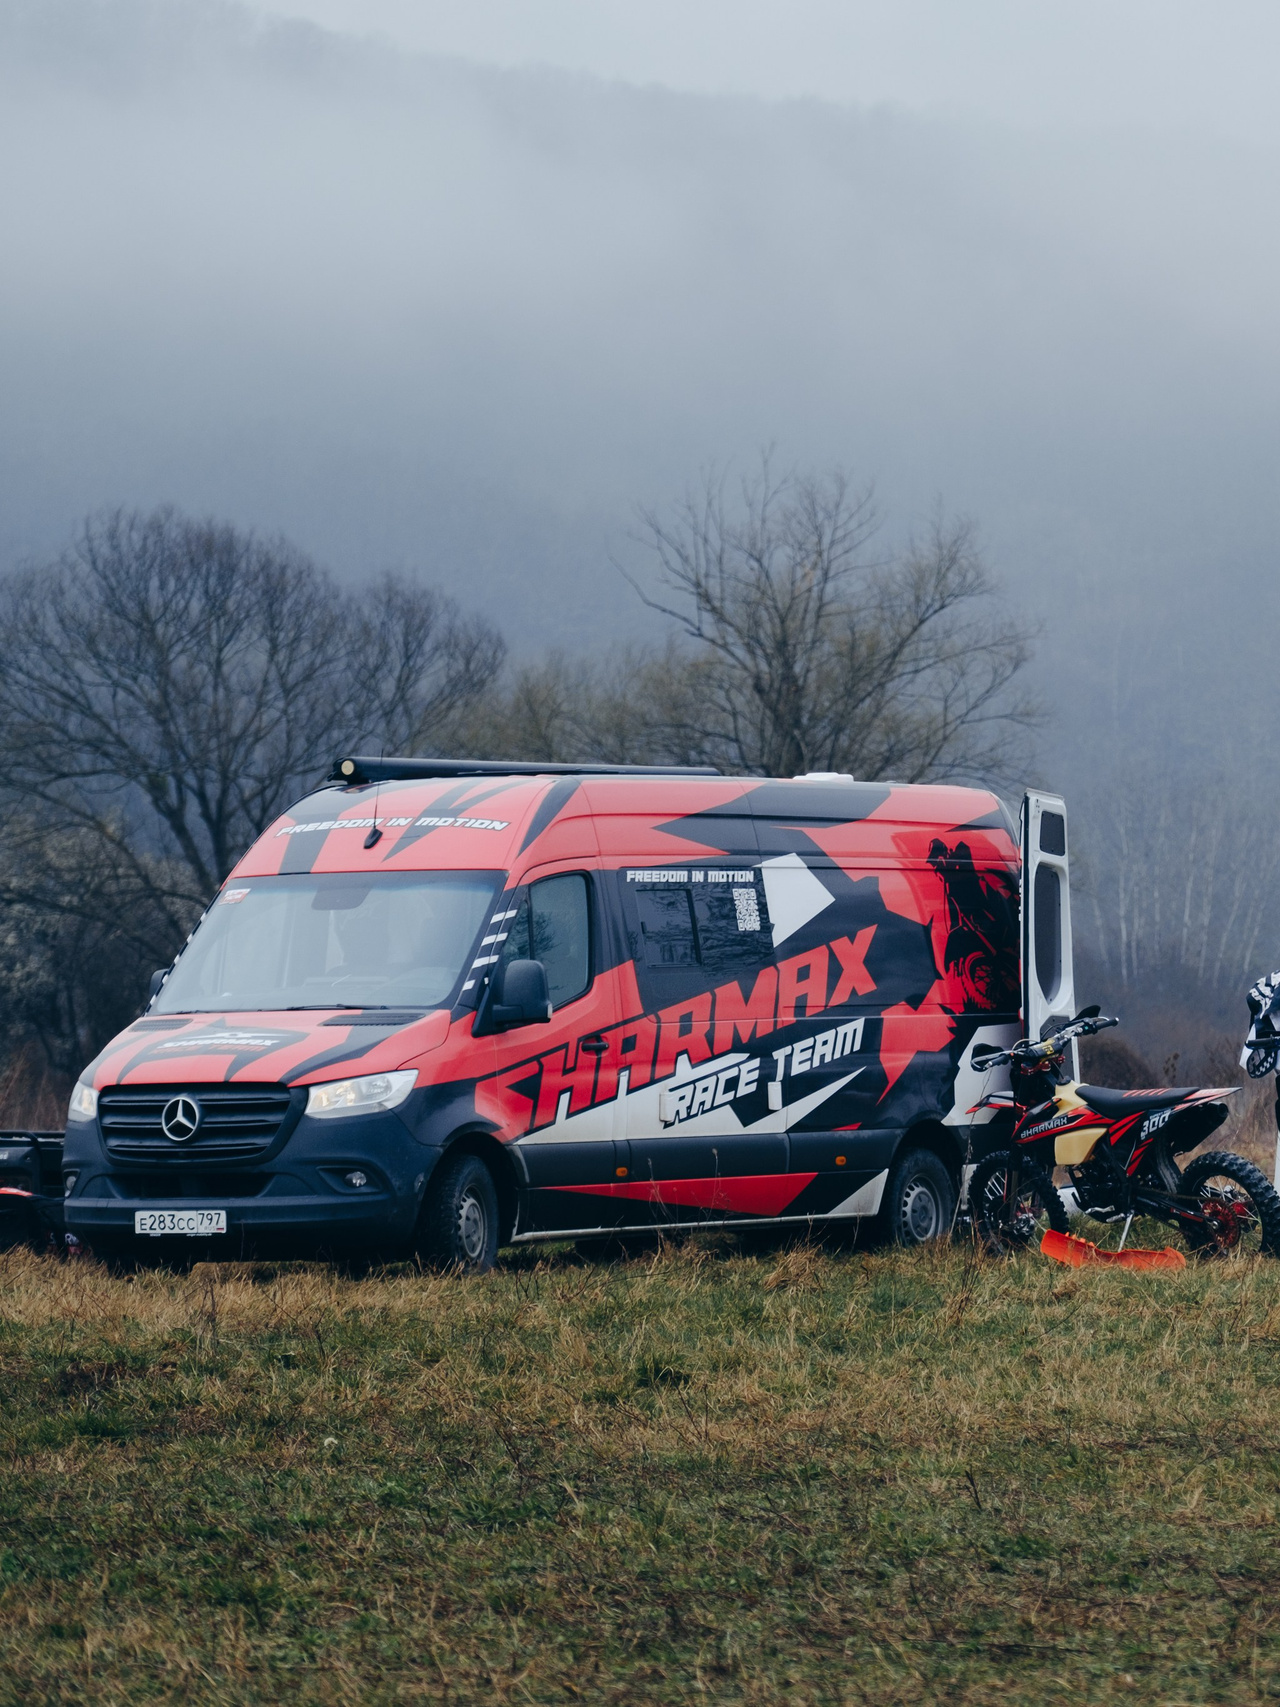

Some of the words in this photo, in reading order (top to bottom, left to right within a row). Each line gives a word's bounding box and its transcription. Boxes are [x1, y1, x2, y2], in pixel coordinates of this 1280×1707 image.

[275, 817, 384, 838] FREEDOM
[385, 816, 413, 828] IN
[415, 816, 511, 831] MOTION
[626, 870, 688, 883] FREEDOM
[691, 870, 704, 883] IN
[707, 870, 754, 883] MOTION
[475, 924, 878, 1143] SHARMAX
[667, 1057, 761, 1125] RACE
[772, 1017, 866, 1082] TEAM
[1140, 1111, 1172, 1140] 300
[140, 1214, 195, 1231] E283CC
[198, 1212, 221, 1226] 797
